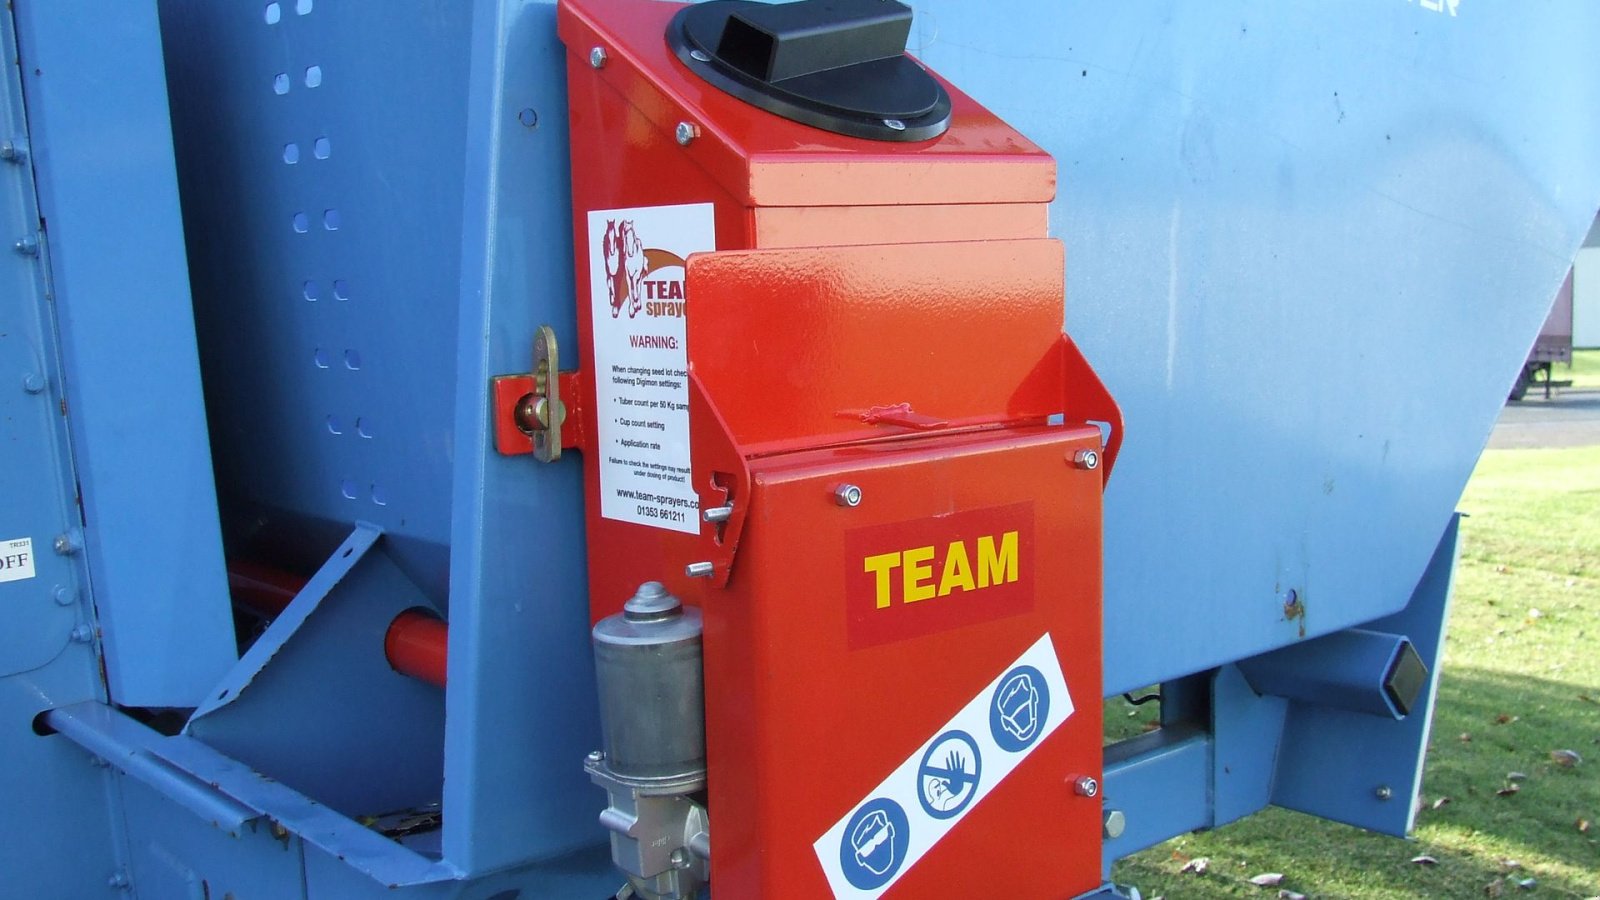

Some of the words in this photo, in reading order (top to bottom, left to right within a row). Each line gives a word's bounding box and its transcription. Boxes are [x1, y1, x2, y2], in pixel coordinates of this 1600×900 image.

[643, 280, 686, 299] TEA
[646, 301, 686, 318] spray
[629, 335, 679, 349] WARNING:
[612, 365, 626, 373] When
[627, 366, 650, 376] changing
[652, 368, 664, 376] seed
[674, 369, 688, 377] chec
[612, 376, 635, 386] following
[636, 378, 658, 388] Digimon
[659, 380, 681, 389] settings:
[619, 397, 633, 406] Tuber
[634, 399, 649, 407] count
[650, 401, 659, 409] per
[668, 401, 675, 411] Kg
[620, 417, 630, 427] Cup
[631, 420, 646, 428] count
[647, 421, 665, 431] setting
[621, 438, 649, 449] Application
[608, 457, 622, 465] Failure
[637, 505, 658, 518] 01353
[659, 509, 685, 523] 661211
[864, 530, 1019, 609] TEAM
